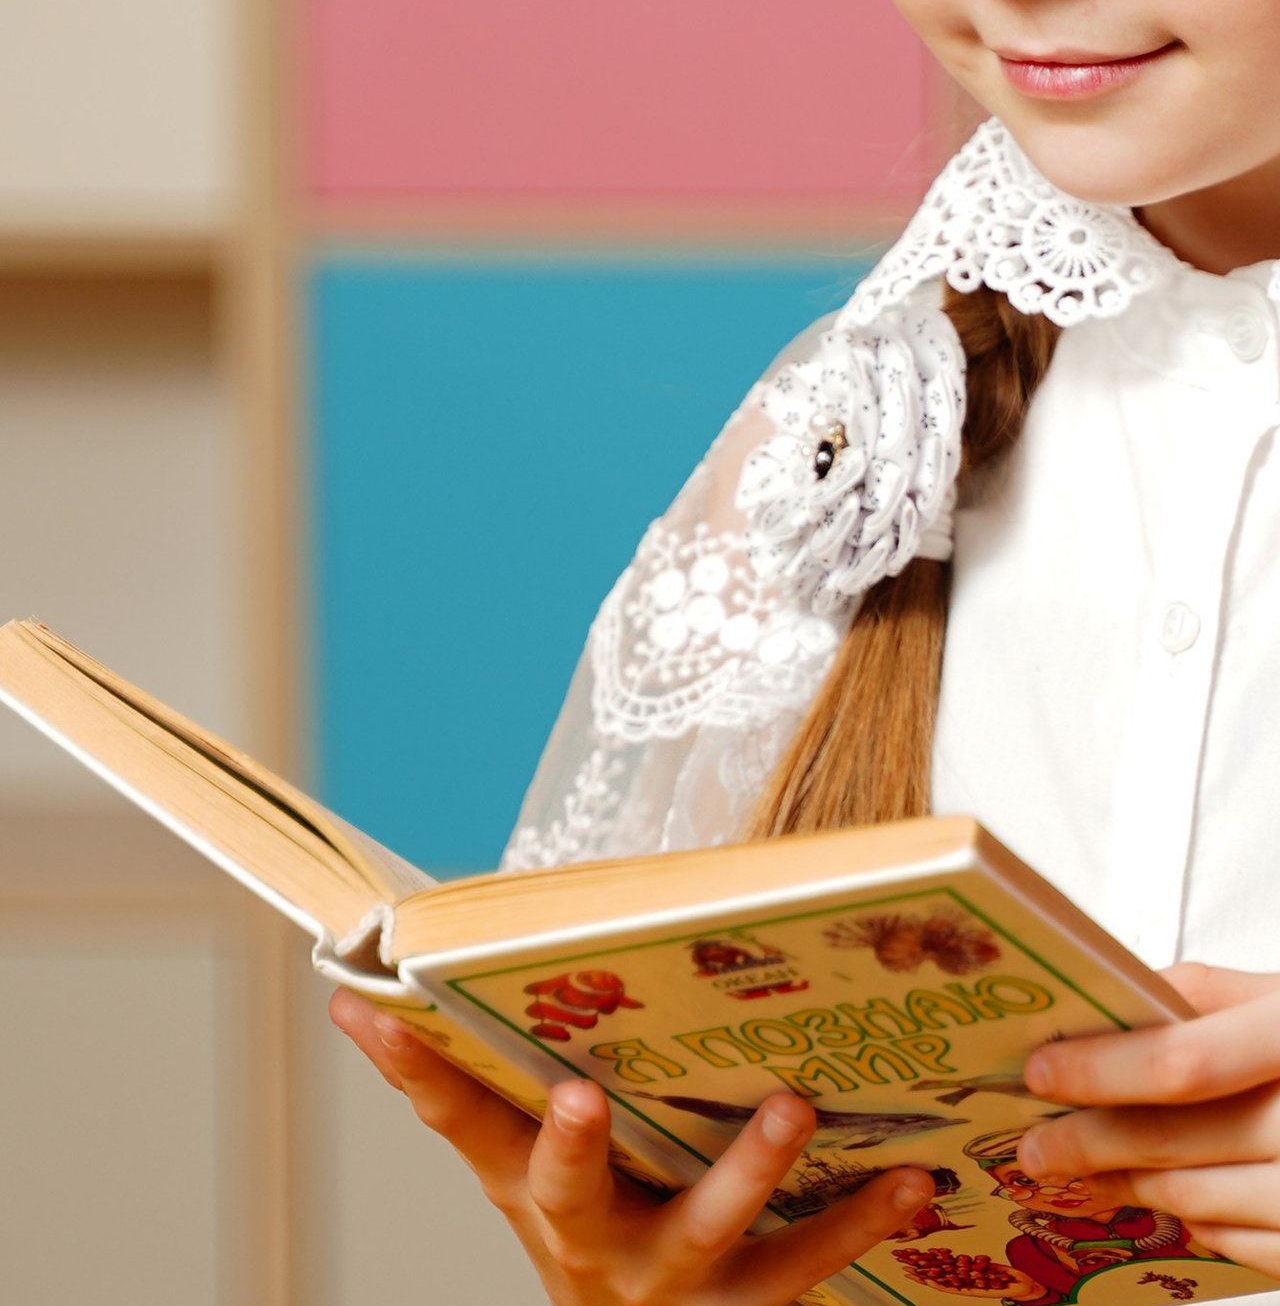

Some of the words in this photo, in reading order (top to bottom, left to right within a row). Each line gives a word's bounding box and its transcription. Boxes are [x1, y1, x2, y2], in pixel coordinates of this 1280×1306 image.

[589, 1038, 687, 1083] Я
[673, 975, 1055, 1068] ПОЗНАЮ
[764, 1034, 958, 1096] МИР
